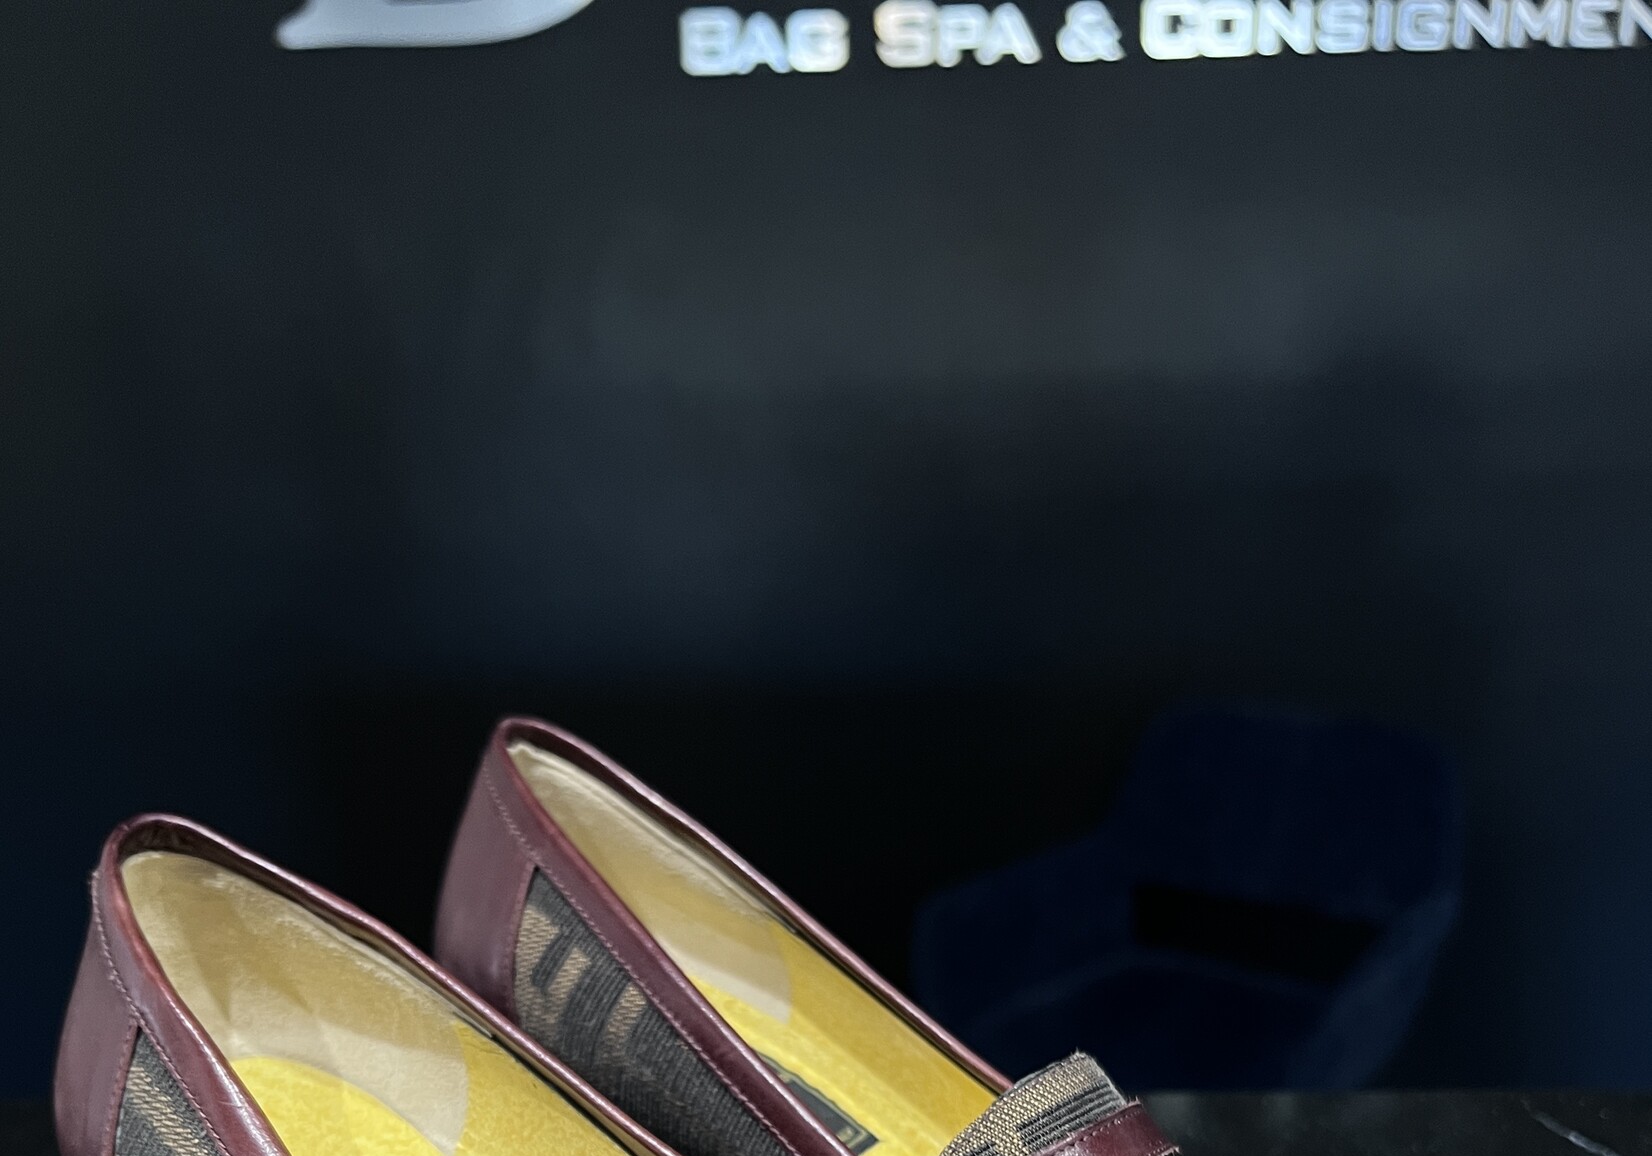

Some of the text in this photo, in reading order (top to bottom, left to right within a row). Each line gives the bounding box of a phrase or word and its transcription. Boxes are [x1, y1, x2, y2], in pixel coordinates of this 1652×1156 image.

[679, 6, 850, 76] BAG
[873, 0, 1042, 68] SPA
[1056, 0, 1125, 62] &
